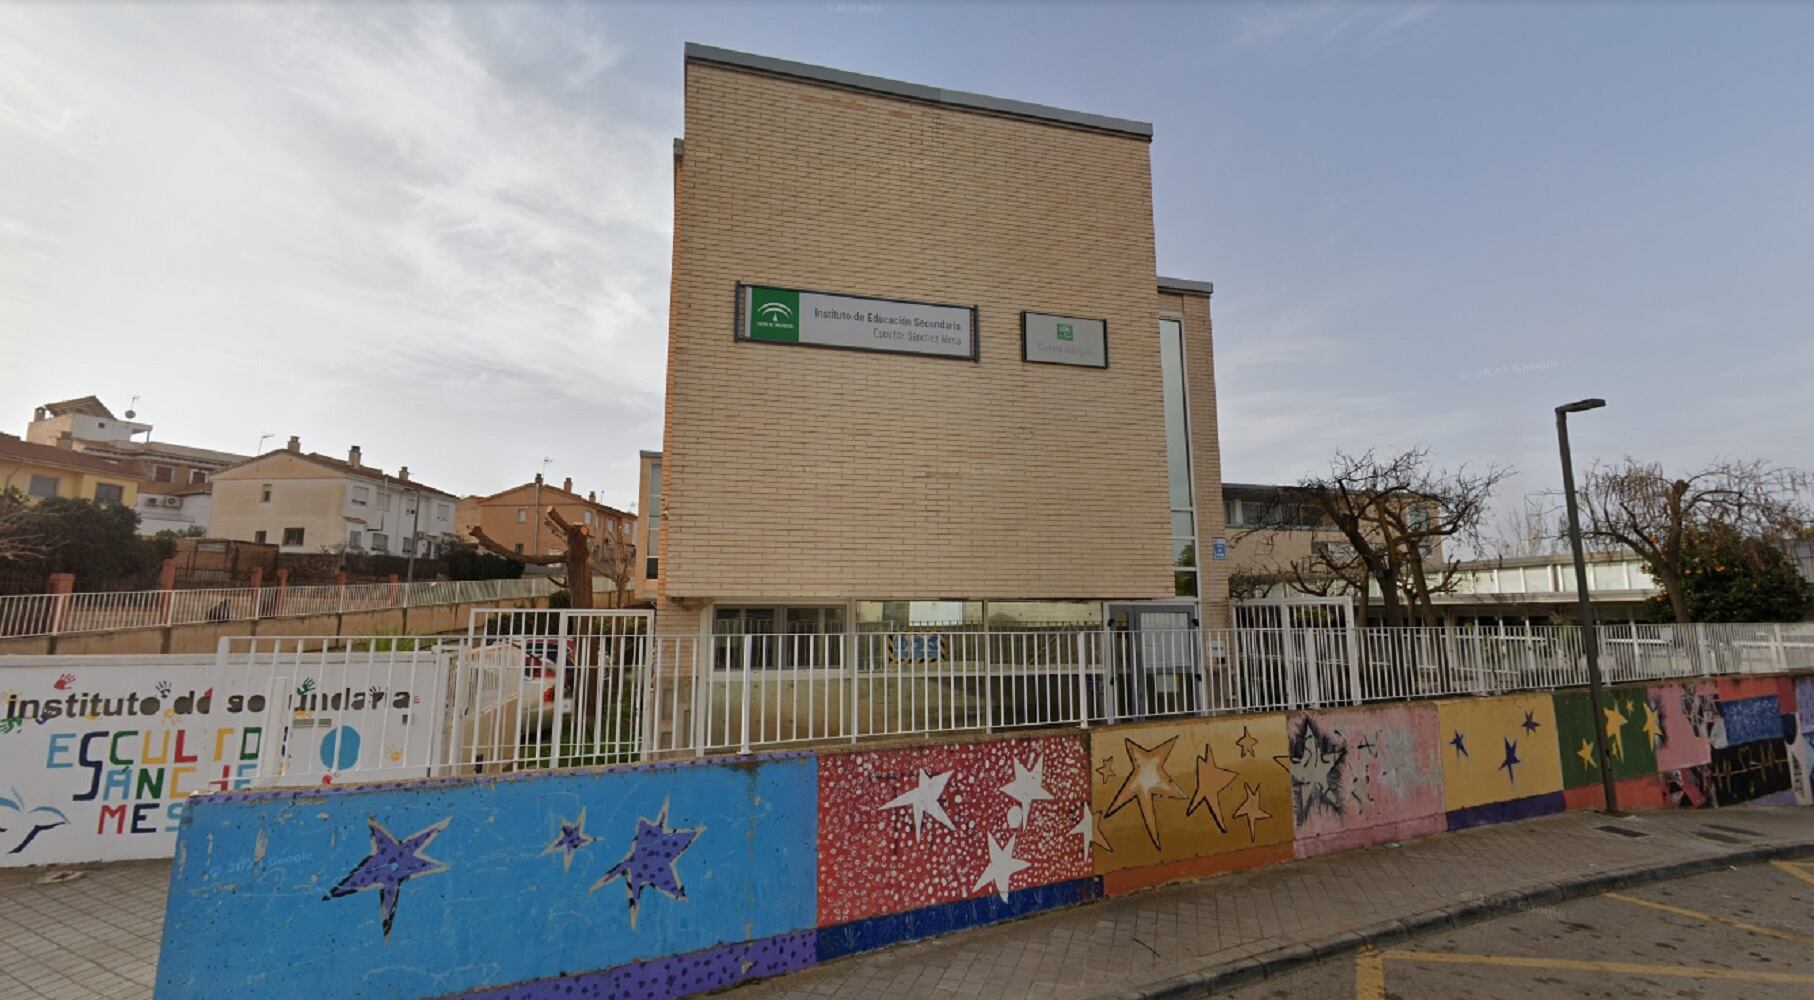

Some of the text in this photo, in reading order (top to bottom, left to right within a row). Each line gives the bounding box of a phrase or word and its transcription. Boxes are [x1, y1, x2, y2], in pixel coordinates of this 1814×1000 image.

[814, 307, 961, 331] Instituto de Educación Secundaria
[6, 691, 160, 719] instituto
[46, 727, 292, 769] ESCULTO
